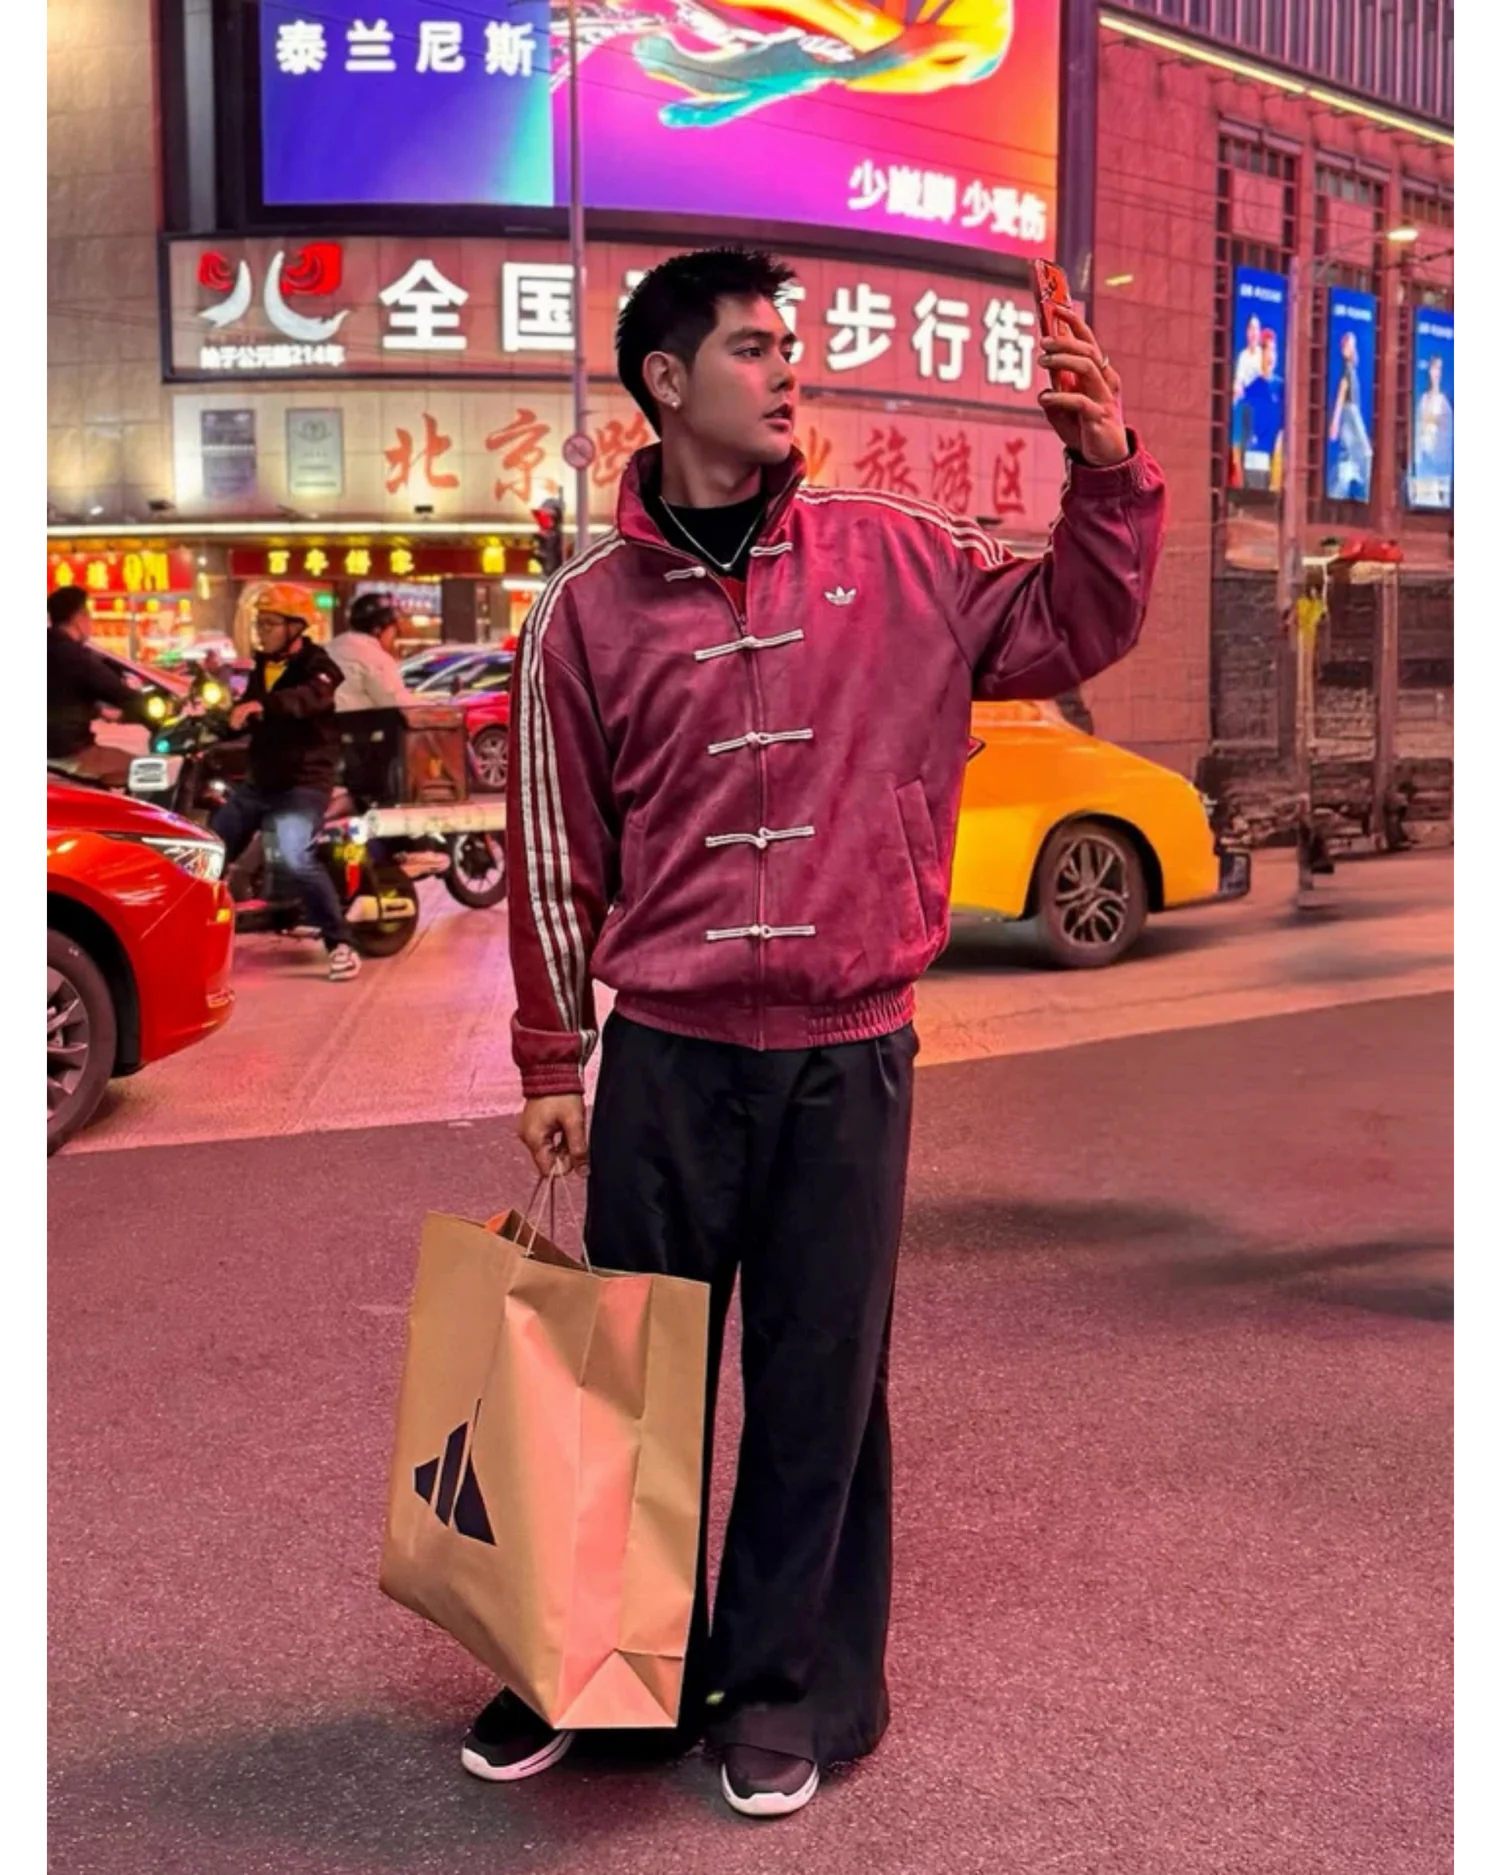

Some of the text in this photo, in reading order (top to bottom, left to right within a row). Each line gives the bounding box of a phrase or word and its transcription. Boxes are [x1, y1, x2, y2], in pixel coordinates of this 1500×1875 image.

[275, 19, 537, 76] 泰兰尼斯
[378, 259, 1035, 391] 全国步行街
